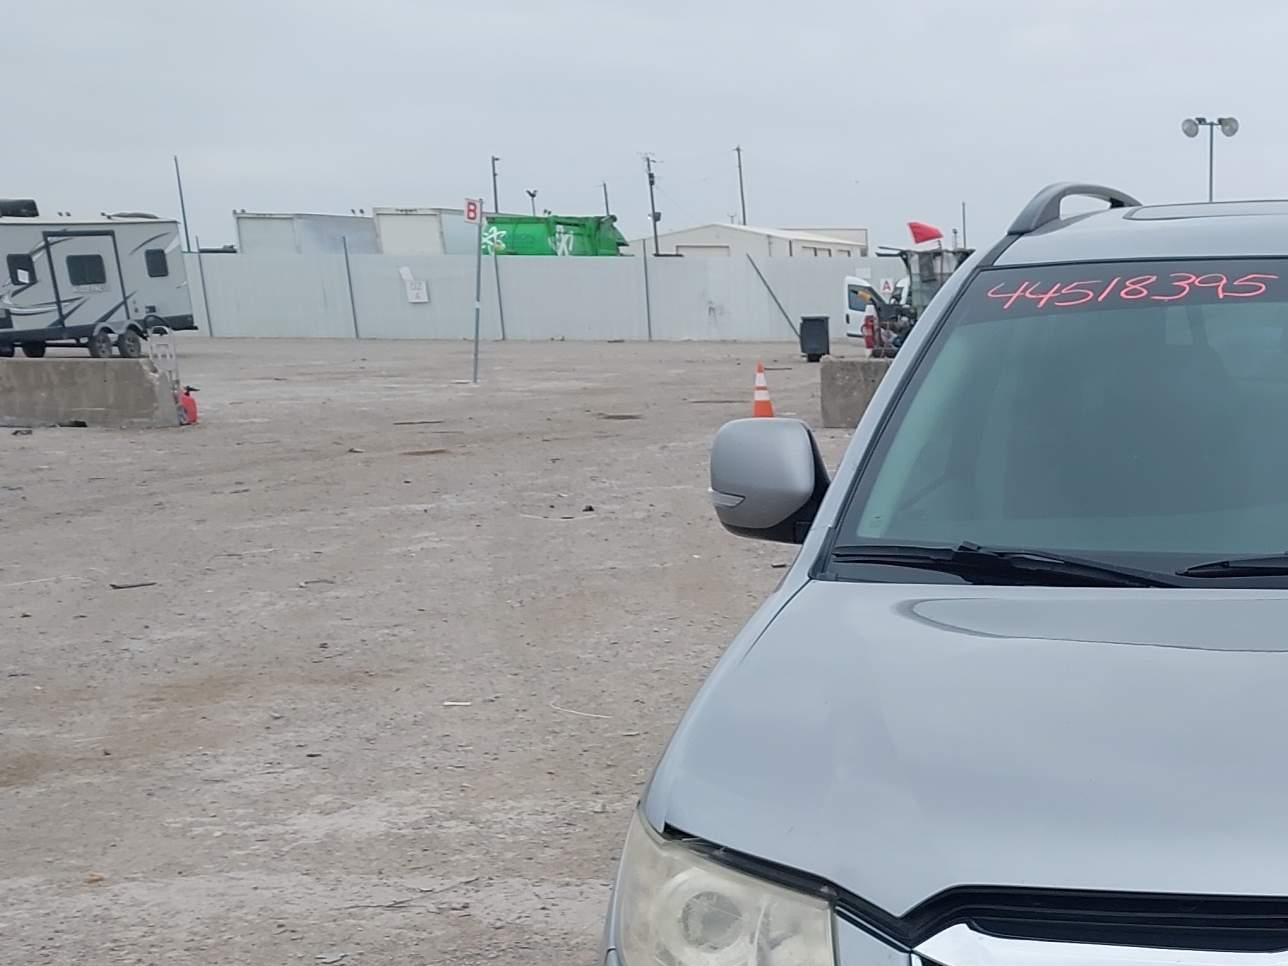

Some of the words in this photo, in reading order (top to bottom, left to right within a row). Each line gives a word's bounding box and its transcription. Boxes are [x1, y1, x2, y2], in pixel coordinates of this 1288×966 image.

[467, 201, 477, 220] B
[882, 280, 892, 291] A
[987, 272, 1279, 310] 44518395
